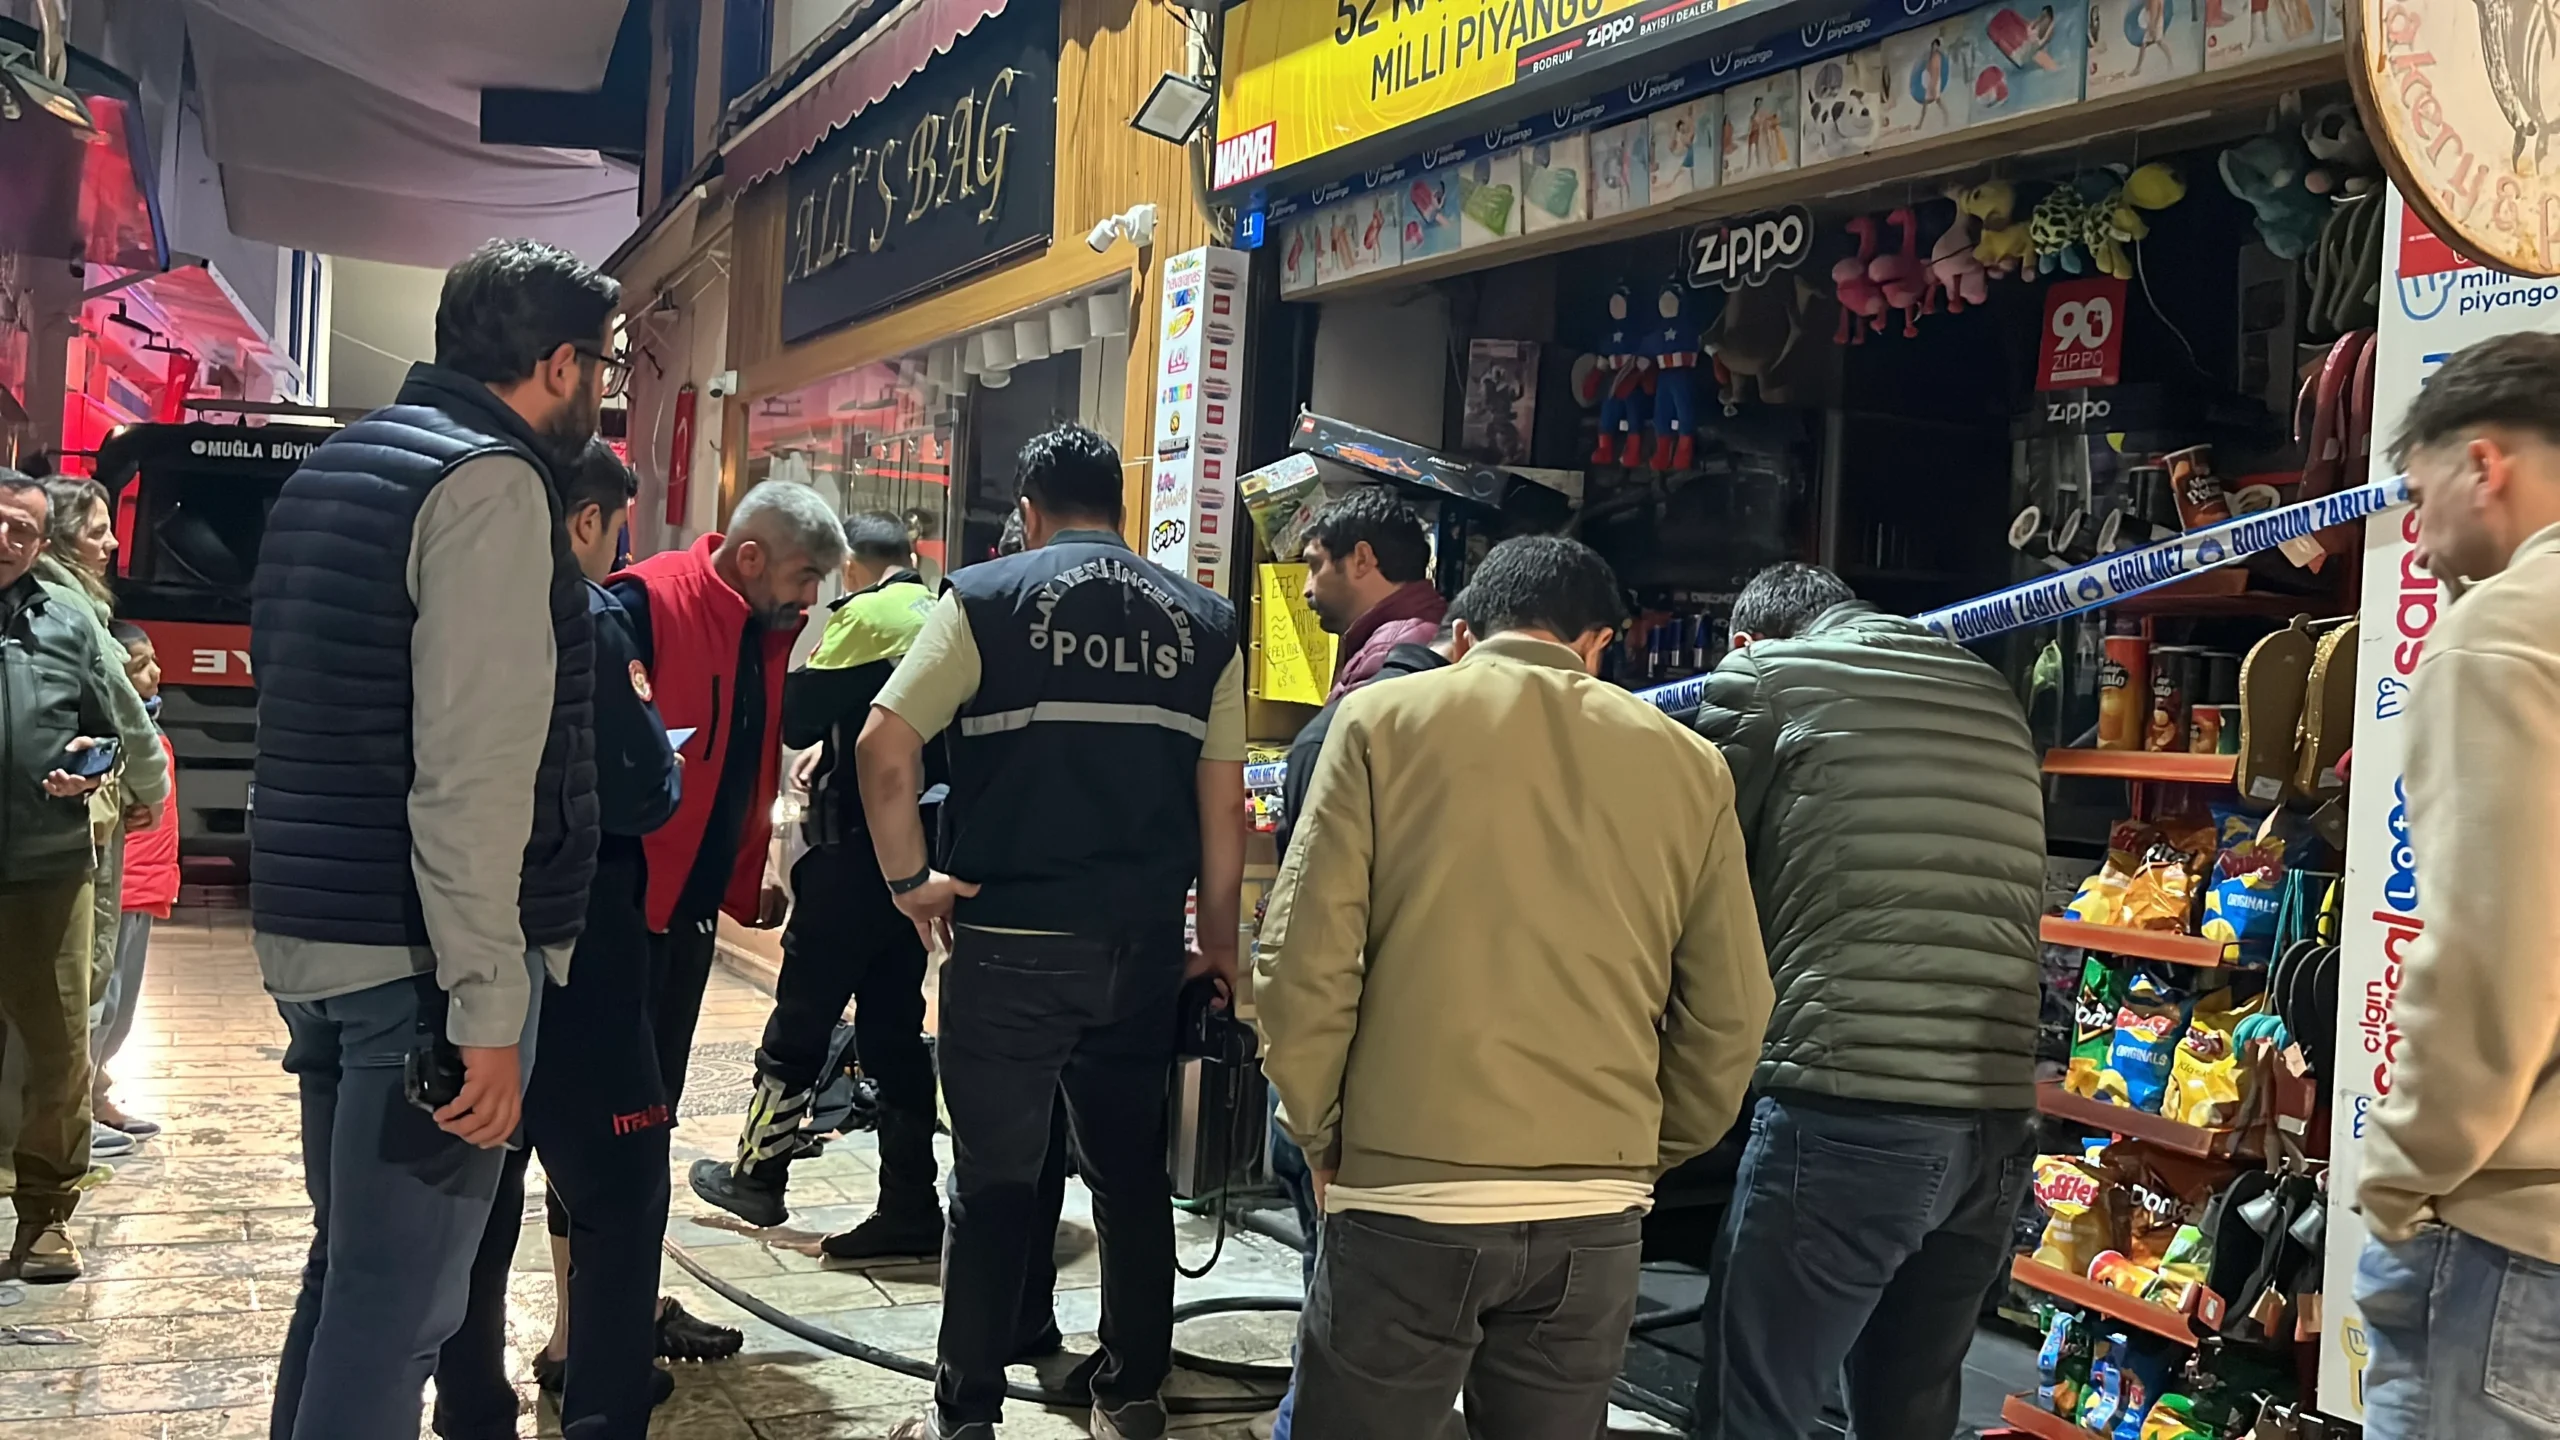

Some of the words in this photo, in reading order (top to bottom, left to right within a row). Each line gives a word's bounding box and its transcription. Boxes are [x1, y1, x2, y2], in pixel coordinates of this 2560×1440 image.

[1370, 14, 1449, 102] MİLLİ
[1532, 49, 1574, 74] BODRUM
[1676, 0, 1714, 24] DEALER
[2381, 5, 2490, 226] akery
[904, 67, 1014, 226] BAG
[1214, 124, 1274, 190] MARVEL
[1242, 215, 1254, 237] 11
[2052, 297, 2113, 352] 90
[2459, 285, 2559, 315] piyango
[2052, 350, 2104, 371] ZIPPO
[207, 439, 263, 458] MUĞLA
[271, 442, 319, 461] BÜYÜ
[2107, 543, 2190, 594] GİRİLMEZ
[2231, 506, 2314, 556] BODRUM
[1271, 574, 1300, 601] EFES
[1951, 597, 2019, 641] BODRUM
[2016, 580, 2075, 621] ZABITA
[1029, 582, 1061, 650] OLAY
[1052, 629, 1178, 679] POLİS
[2227, 892, 2280, 915] ORIGINALS
[2115, 1044, 2169, 1067] ORIGINALS
